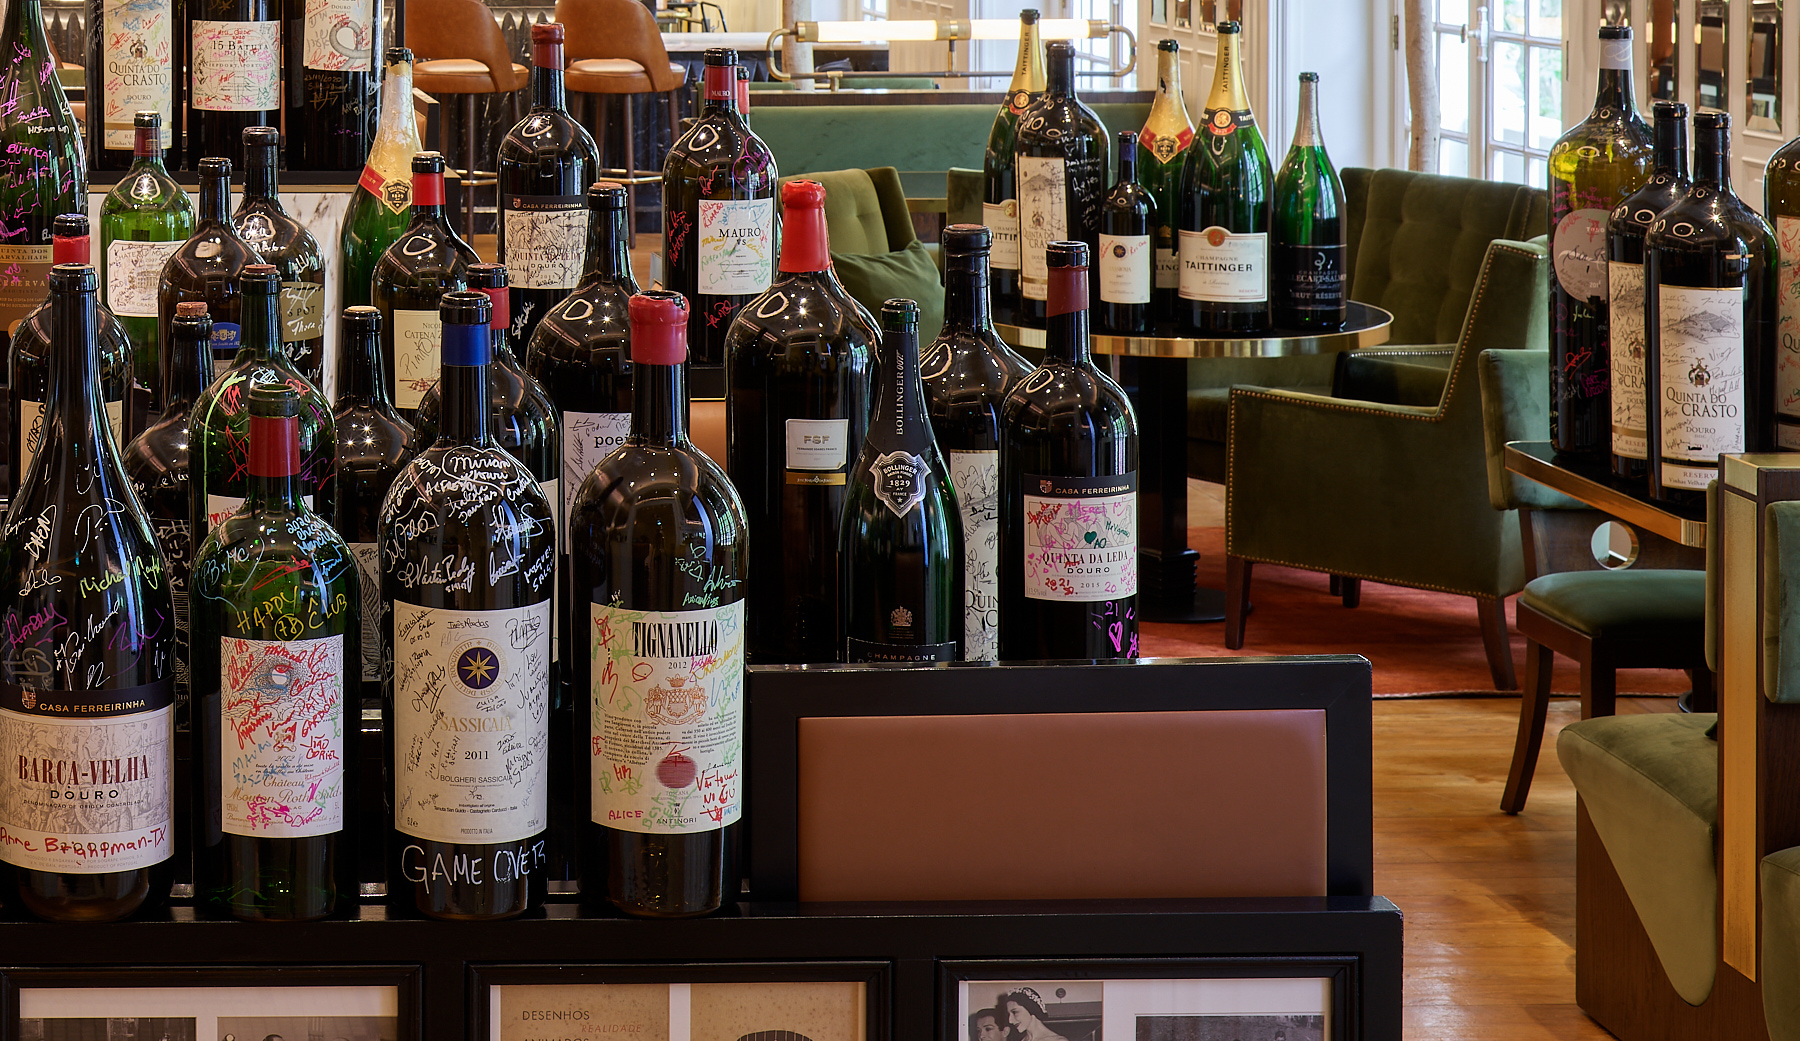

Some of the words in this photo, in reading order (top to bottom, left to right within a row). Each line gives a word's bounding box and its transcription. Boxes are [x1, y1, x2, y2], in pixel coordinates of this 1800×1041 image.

[1020, 29, 1030, 77] TAITTINGER
[108, 61, 145, 77] QUINTA
[147, 63, 161, 74] DO
[1221, 45, 1230, 94] TAITTINGER
[122, 73, 167, 87] CRASTO
[711, 89, 731, 97] MAURO
[718, 227, 762, 238] MAURO
[29, 247, 49, 255] DOS
[1195, 254, 1239, 262] CHAMPAGNE
[1184, 261, 1254, 272] TAITTINGER
[1291, 291, 1311, 299] BRUT
[1314, 290, 1342, 300] RÉSERVE
[403, 329, 436, 340] CATENA
[895, 350, 905, 371] 007
[1613, 358, 1643, 375] QUINTA
[1665, 386, 1708, 405] QUINTA
[1710, 393, 1727, 404] DO
[895, 371, 904, 436] BOLLINGER
[1680, 402, 1738, 419] CRASTO
[1685, 425, 1716, 435] DOURO
[803, 434, 831, 445] FSF
[882, 464, 918, 476] BOLLINGER
[889, 478, 911, 488] 1829
[1668, 476, 1687, 485] Vinhas
[1687, 478, 1707, 487] Velhas
[1055, 487, 1080, 496] CASA
[1081, 483, 1131, 495] FERREIRINHA
[1042, 551, 1086, 566] QUINTA
[1088, 552, 1104, 564] DA
[1106, 549, 1129, 563] LEDA
[1067, 566, 1111, 575] DOURO
[1080, 581, 1101, 590] 2015
[237, 585, 298, 635] HAPPY
[277, 614, 299, 637] 78
[632, 619, 718, 659] TIGNANELLO
[866, 651, 937, 661] CHAMPAGNE
[668, 661, 688, 670] 2012
[39, 702, 70, 713] CASA
[73, 699, 146, 713] FERREIRINHA
[439, 716, 513, 732] SASSICAIA
[464, 750, 489, 760] 2011
[18, 754, 149, 786] BARCA-VELHA
[263, 774, 305, 788] Château
[440, 774, 477, 783] BOLGHERI
[478, 774, 513, 783] SASSICAIA
[50, 789, 119, 800] DOURO
[225, 785, 275, 804] Mouton
[608, 809, 644, 821] ALICE
[656, 816, 698, 825] ANTINORI
[0, 826, 38, 852] Anne
[402, 844, 483, 895] GAME
[493, 840, 546, 884] OVER
[522, 1010, 590, 1021] DESENHOS
[581, 1024, 642, 1033] REALIDADE
